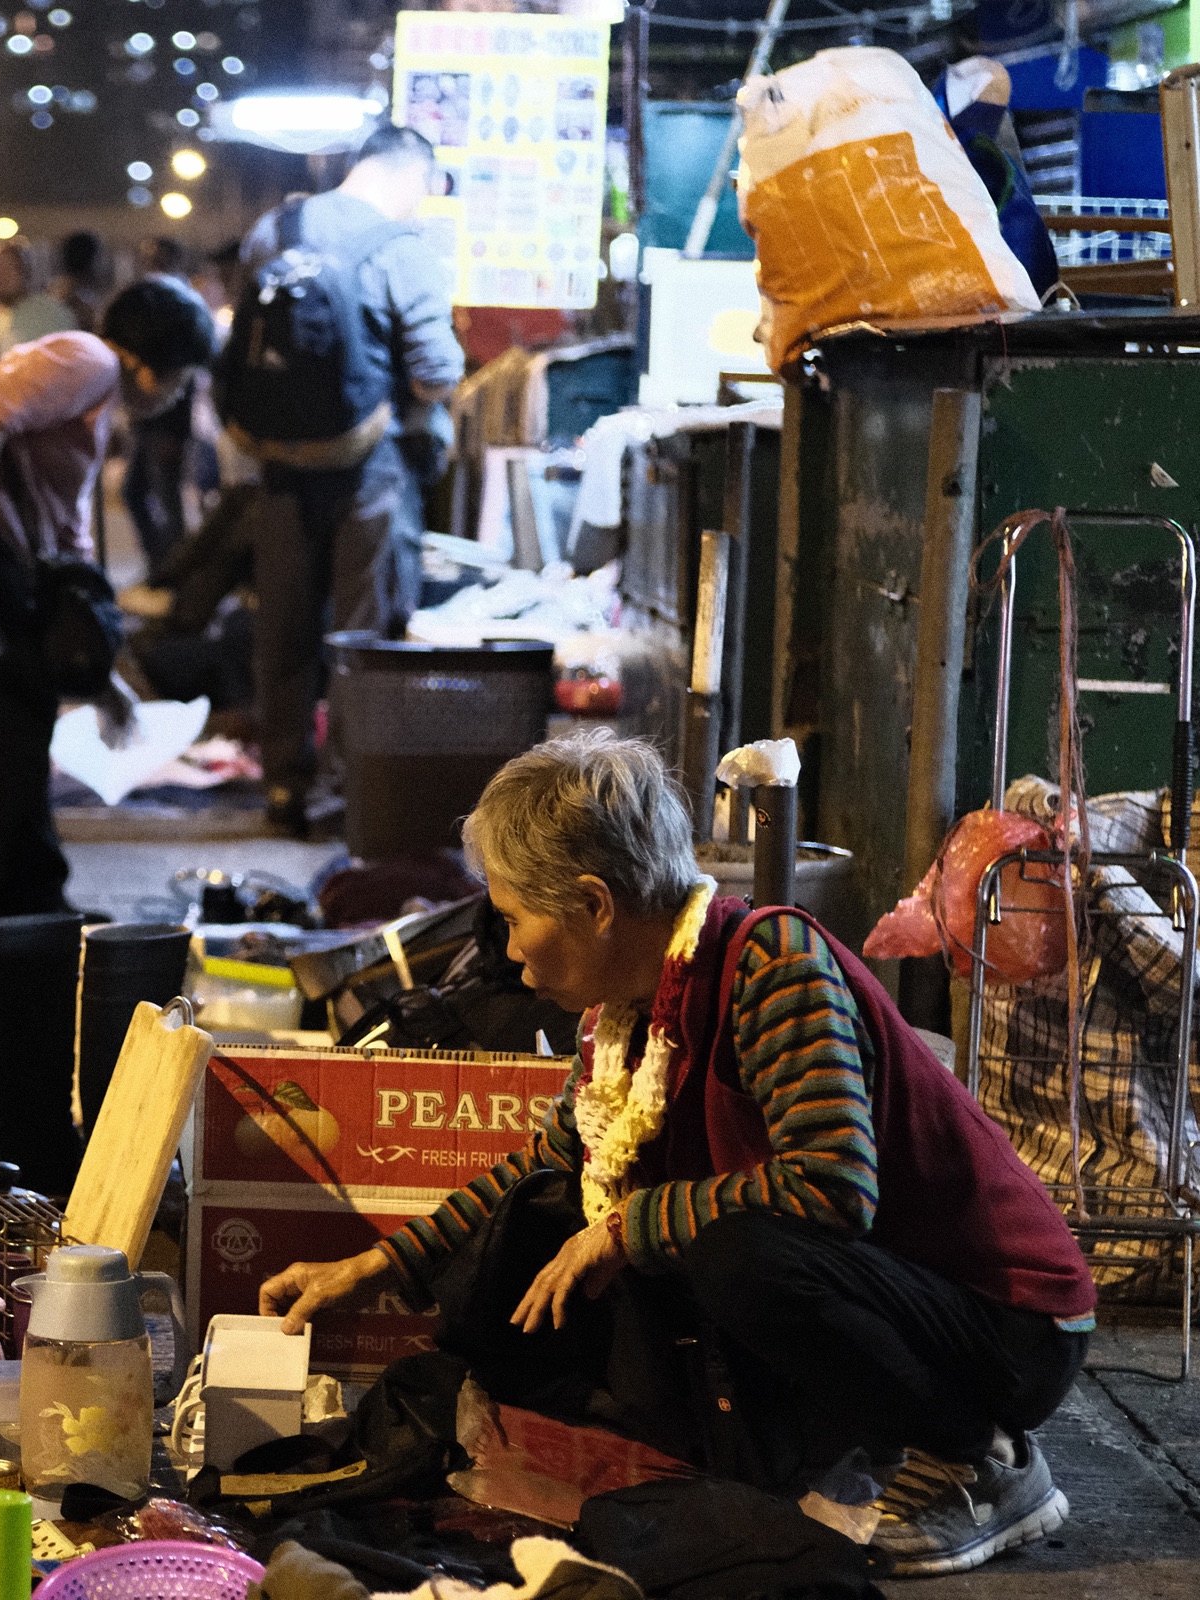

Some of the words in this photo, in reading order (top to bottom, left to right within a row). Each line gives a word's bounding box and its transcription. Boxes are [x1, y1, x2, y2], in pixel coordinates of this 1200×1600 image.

[376, 1088, 554, 1132] PEARS
[422, 1149, 467, 1167] FRESH
[316, 1334, 355, 1350] RESH
[356, 1335, 396, 1353] FRUIT
